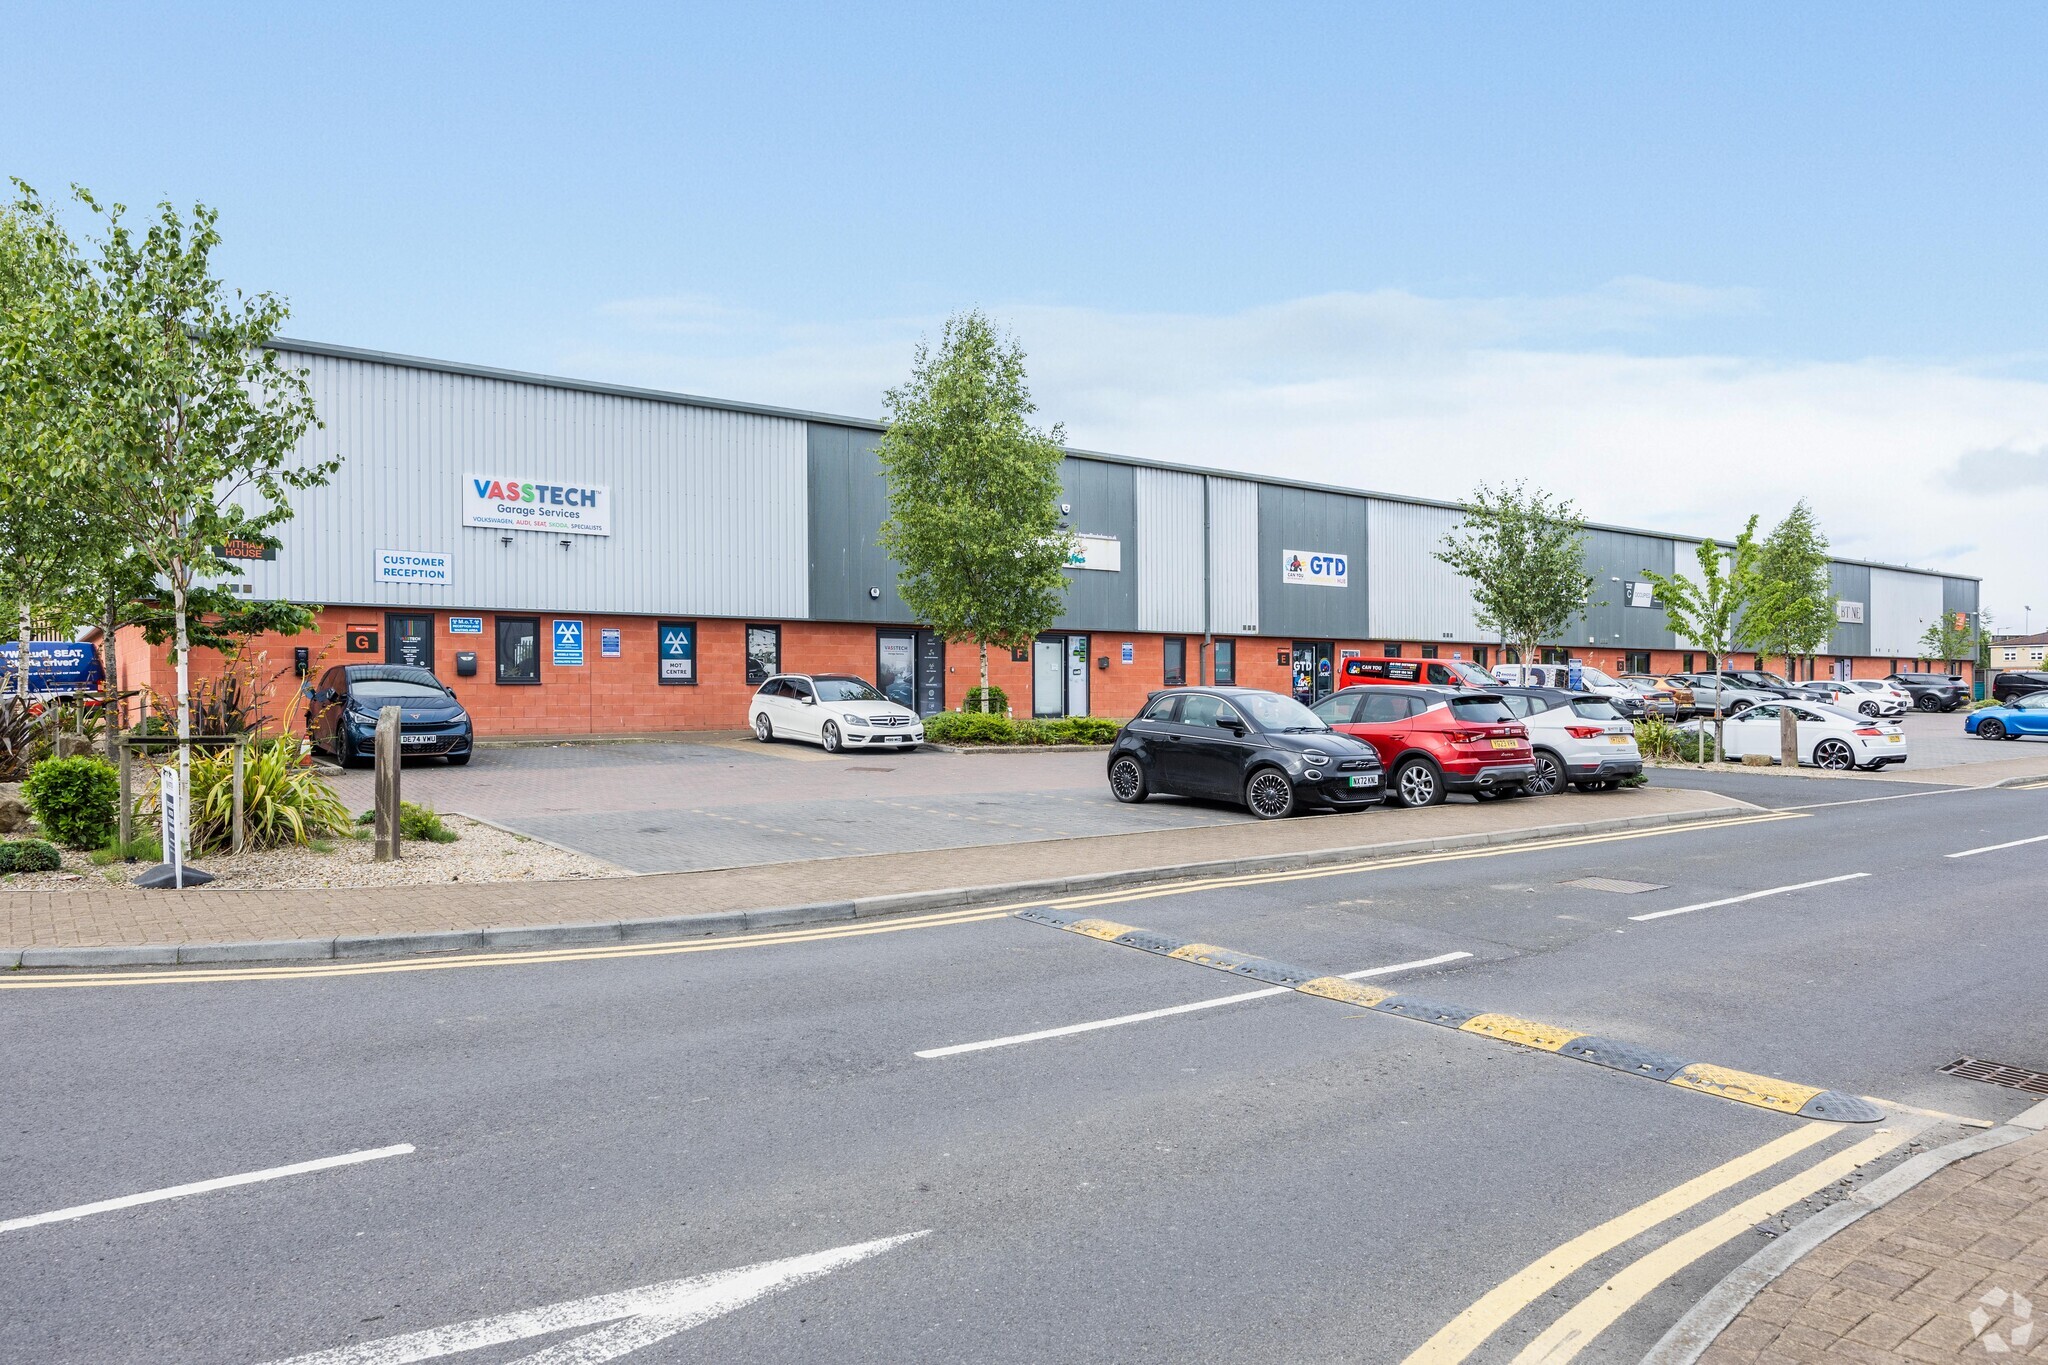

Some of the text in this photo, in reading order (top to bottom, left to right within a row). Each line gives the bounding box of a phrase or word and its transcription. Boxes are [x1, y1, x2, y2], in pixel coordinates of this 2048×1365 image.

[473, 479, 596, 507] VASSTECH
[497, 504, 580, 519] Garage Services
[473, 516, 514, 525] VOLKSWAGEN,
[570, 523, 602, 531] SPECIALISTS
[225, 548, 263, 558] HOUSE
[383, 556, 445, 567] CUSTOMER
[1310, 556, 1346, 576] GTD
[383, 568, 445, 579] RECEPTION
[1627, 590, 1632, 598] C
[355, 635, 369, 649] G
[54, 649, 84, 658] SEAT,
[1017, 649, 1023, 658] F
[7, 658, 80, 667] Skda driver?
[1281, 655, 1286, 663] E
[1293, 661, 1312, 671] GTD
[1353, 776, 1377, 785] NX72 KNL
